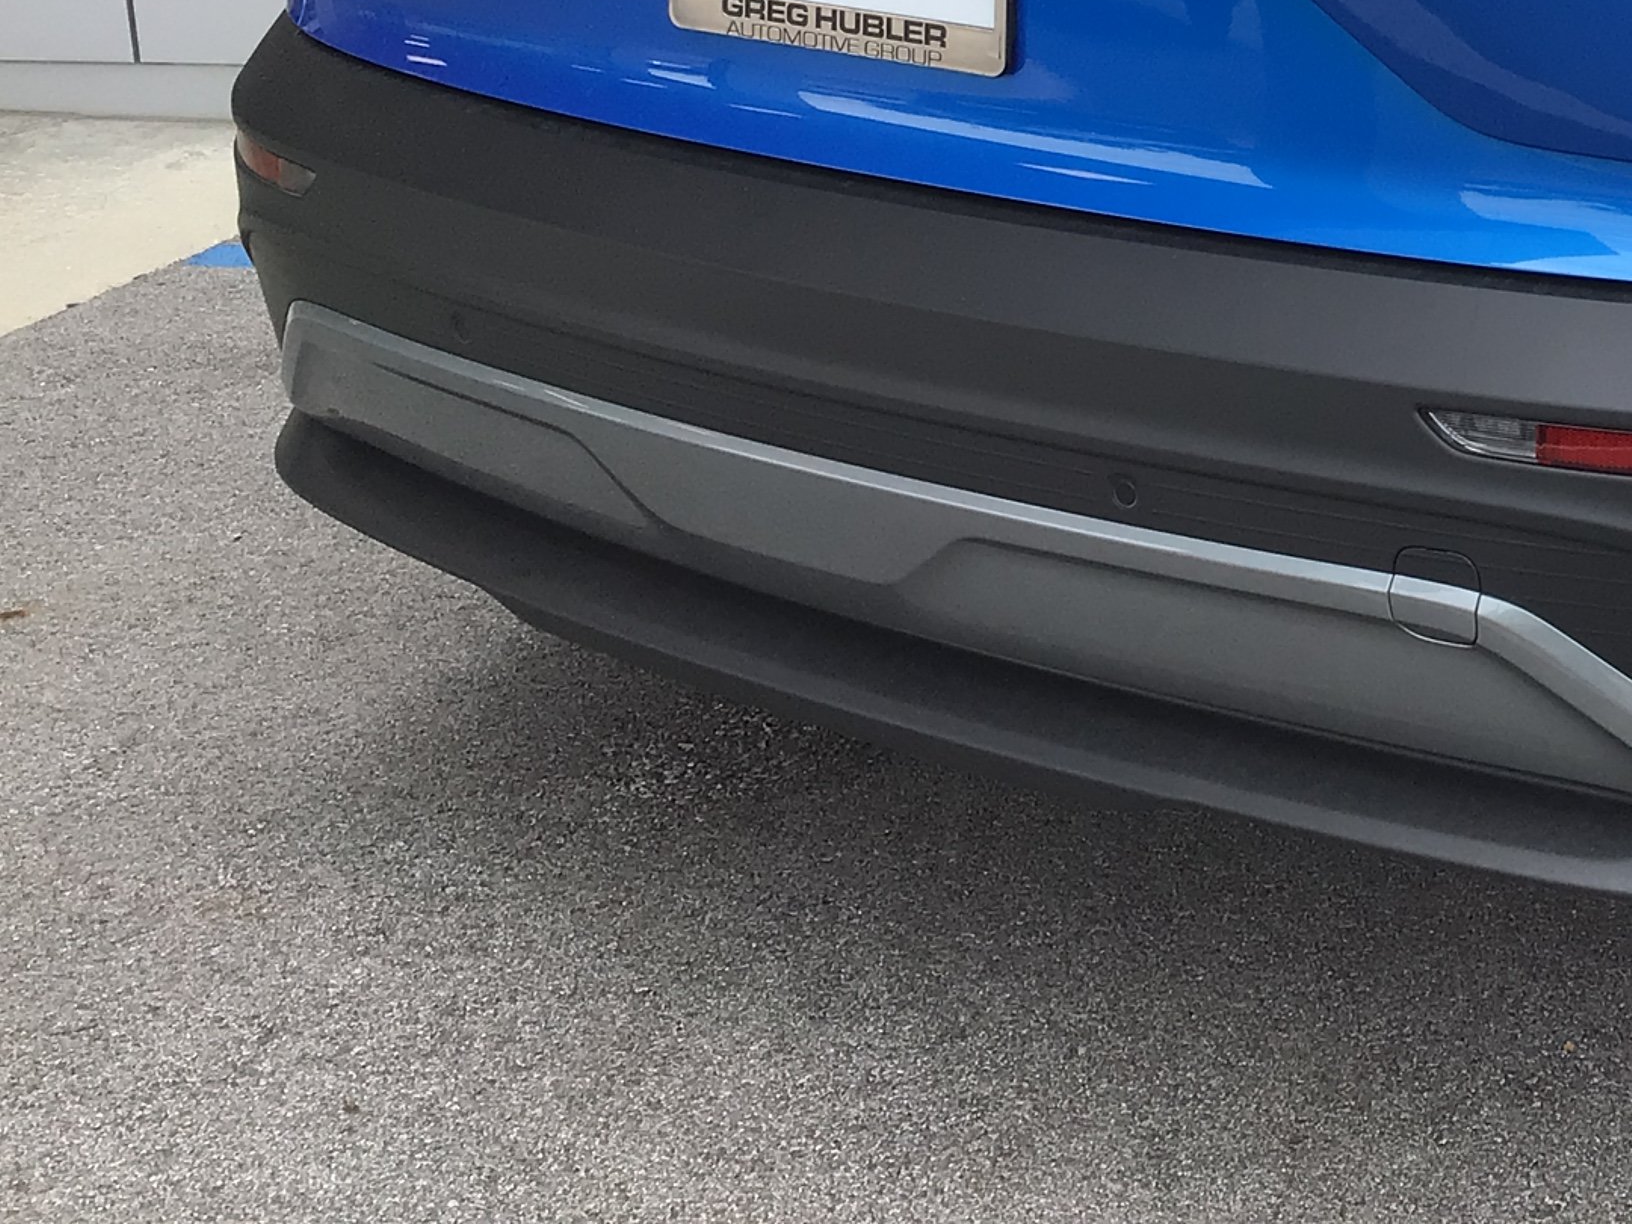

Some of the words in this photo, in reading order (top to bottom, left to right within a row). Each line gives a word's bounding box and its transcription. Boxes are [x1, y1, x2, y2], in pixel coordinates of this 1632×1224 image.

[726, 20, 860, 54] AUTOMOTIVE
[864, 41, 943, 66] GROUP
[815, 8, 947, 47] HUBLER
